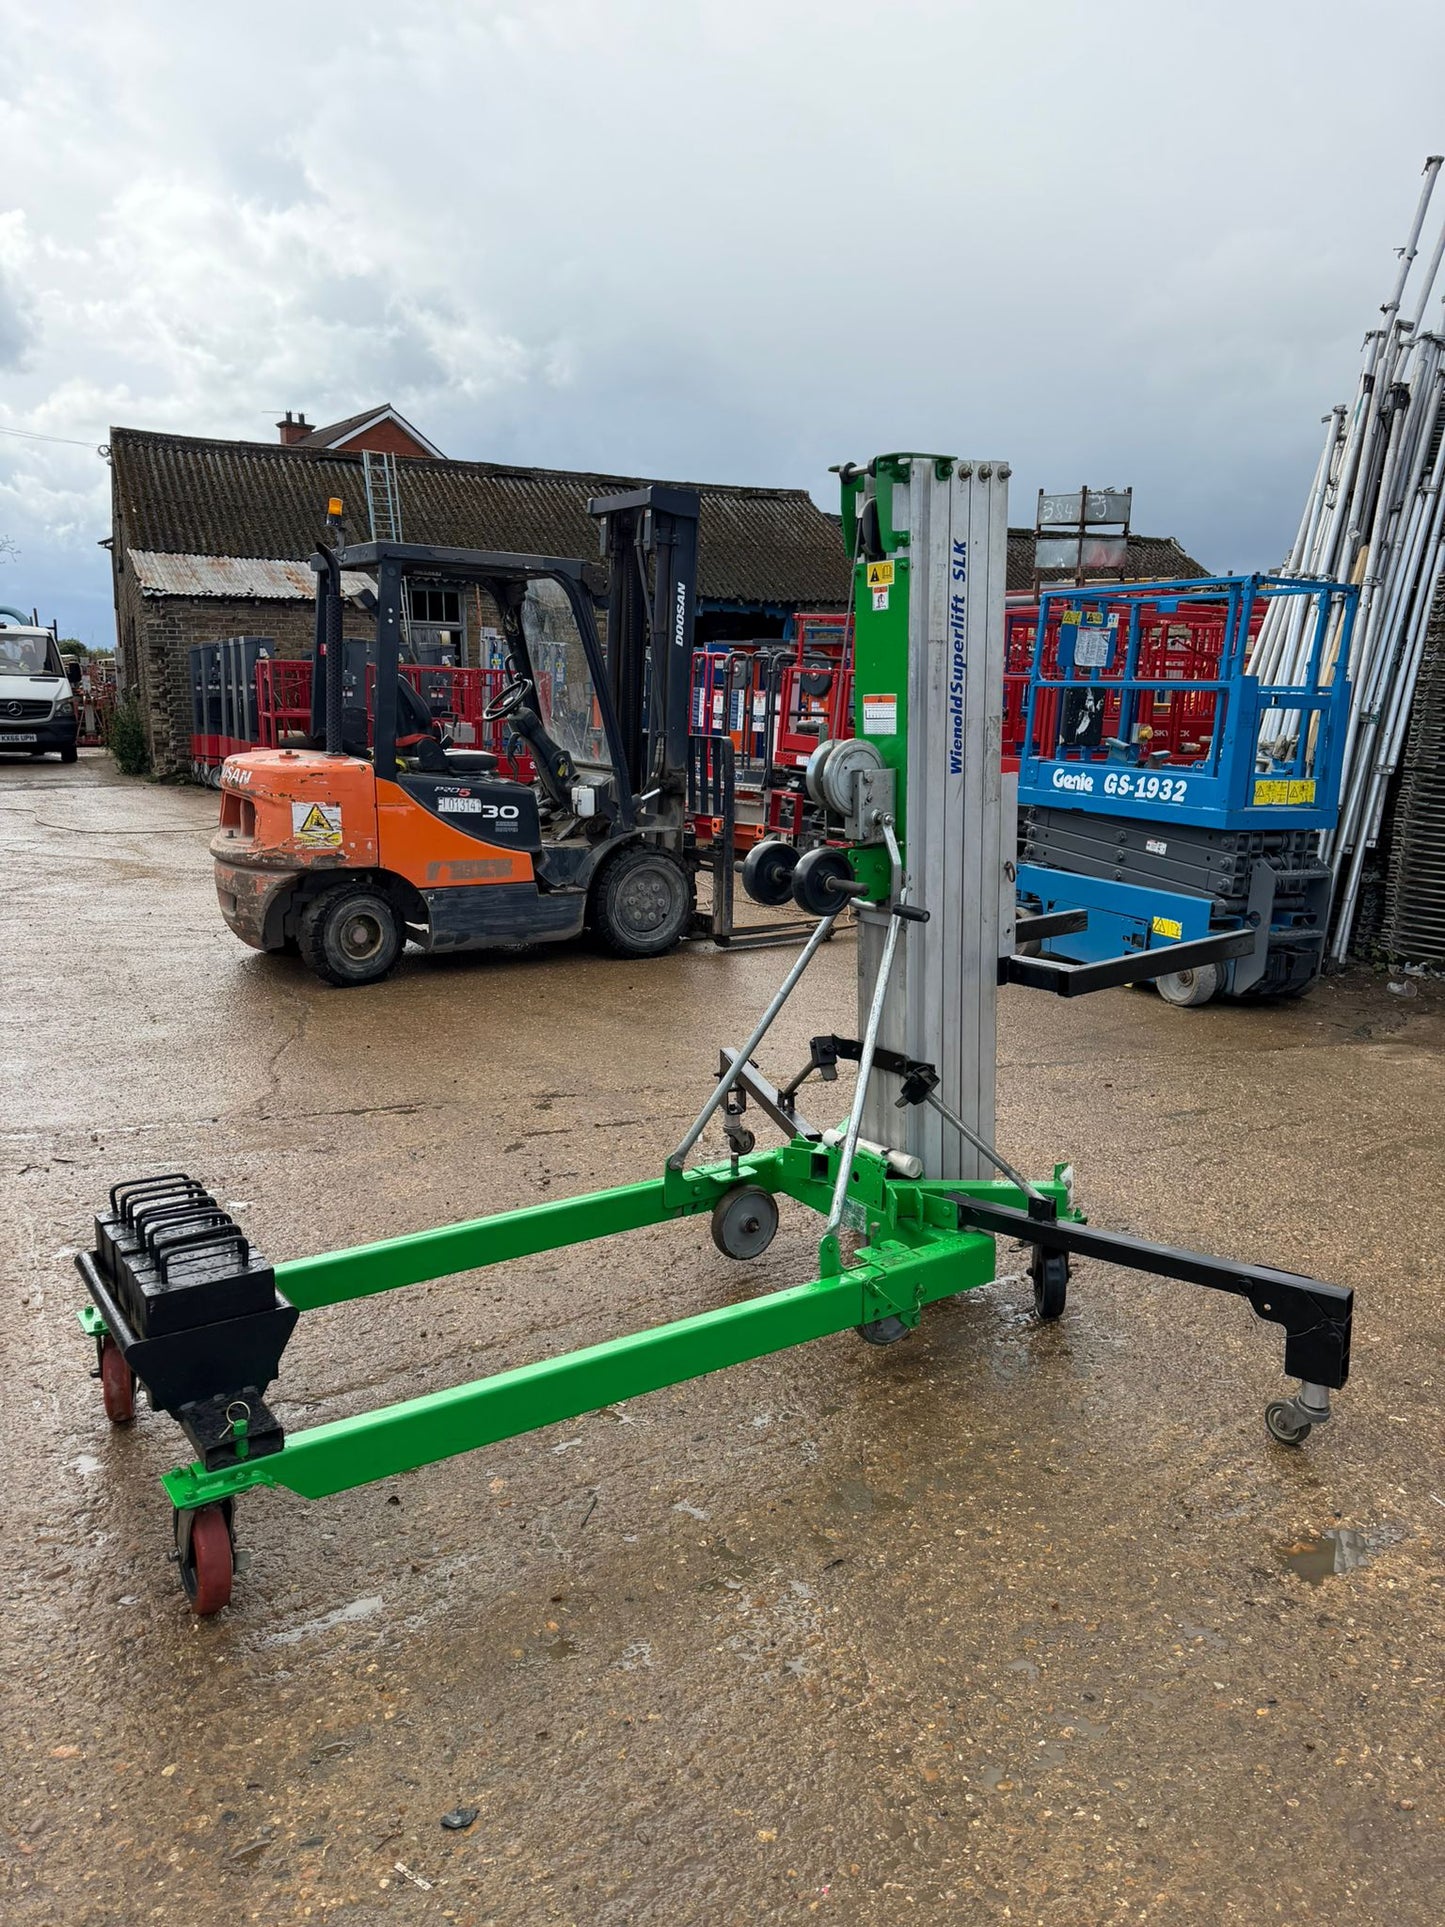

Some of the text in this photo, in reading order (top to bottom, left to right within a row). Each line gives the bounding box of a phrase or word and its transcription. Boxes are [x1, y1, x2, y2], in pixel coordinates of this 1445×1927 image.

[953, 538, 967, 582] SLK
[675, 581, 686, 647] DOOSAN
[1052, 768, 1187, 802] Genie GS-1932
[482, 805, 519, 819] 30
